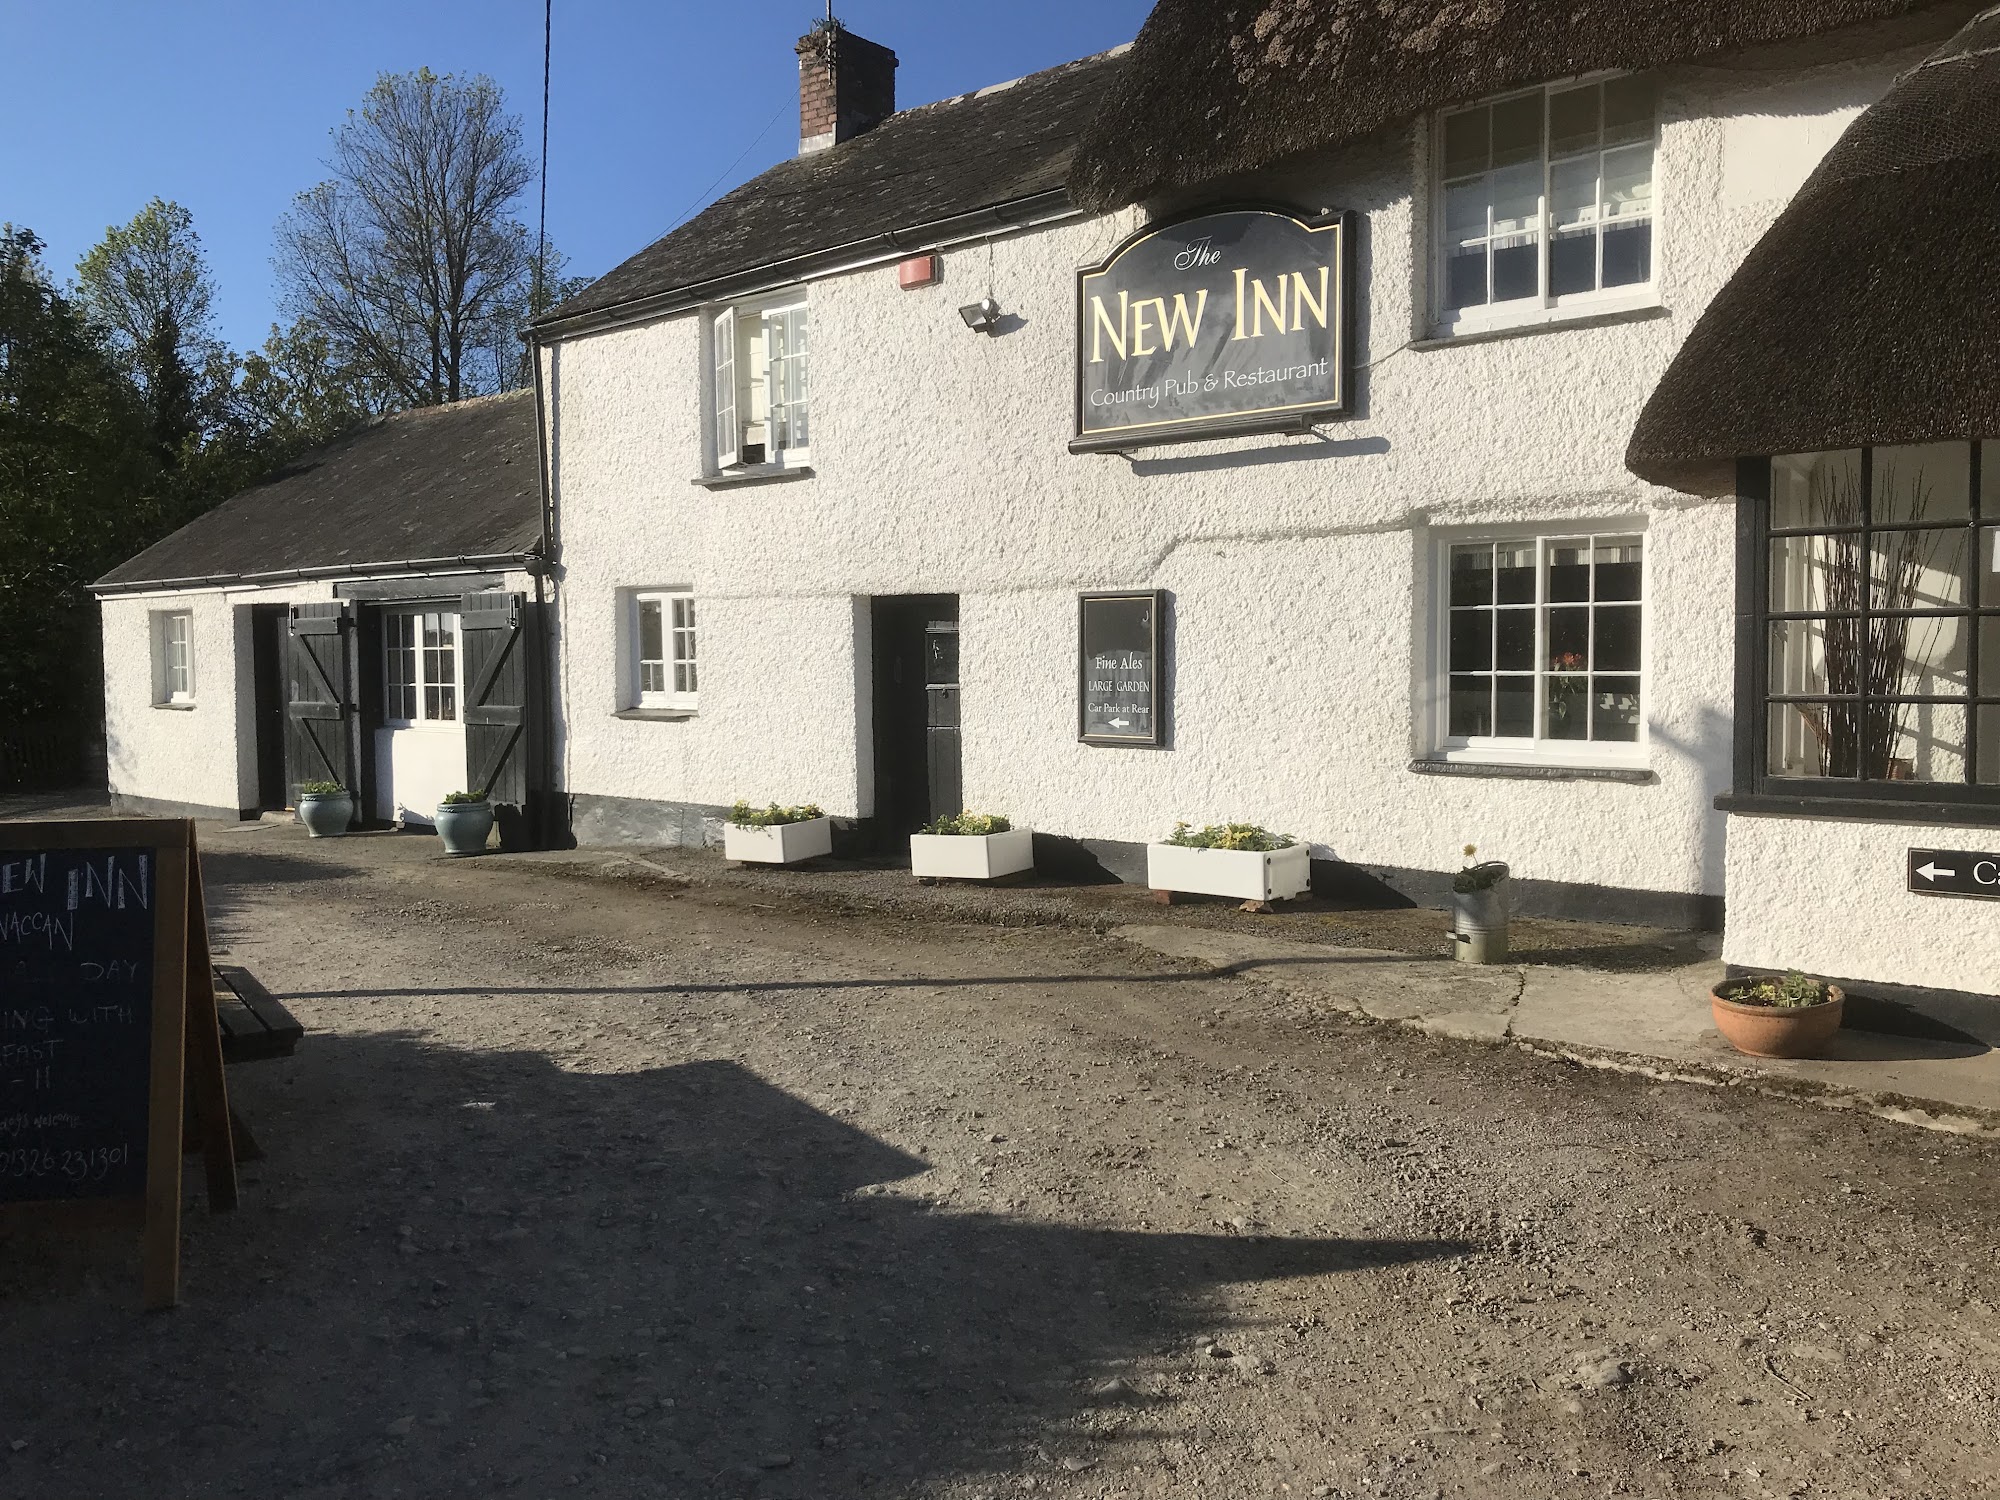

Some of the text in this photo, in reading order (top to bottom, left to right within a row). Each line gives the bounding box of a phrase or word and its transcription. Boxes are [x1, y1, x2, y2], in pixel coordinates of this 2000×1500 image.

[1174, 235, 1222, 271] The
[1090, 266, 1330, 363] NEW INN
[1090, 357, 1328, 408] Country Pub & Restaurant
[1095, 651, 1143, 670] Fine Ales
[1088, 680, 1150, 693] LARGE GARDEN
[1088, 702, 1150, 714] Car Park at Rear
[67, 854, 148, 911] INN
[1973, 861, 2000, 886] C
[61, 1143, 128, 1182] 231301
